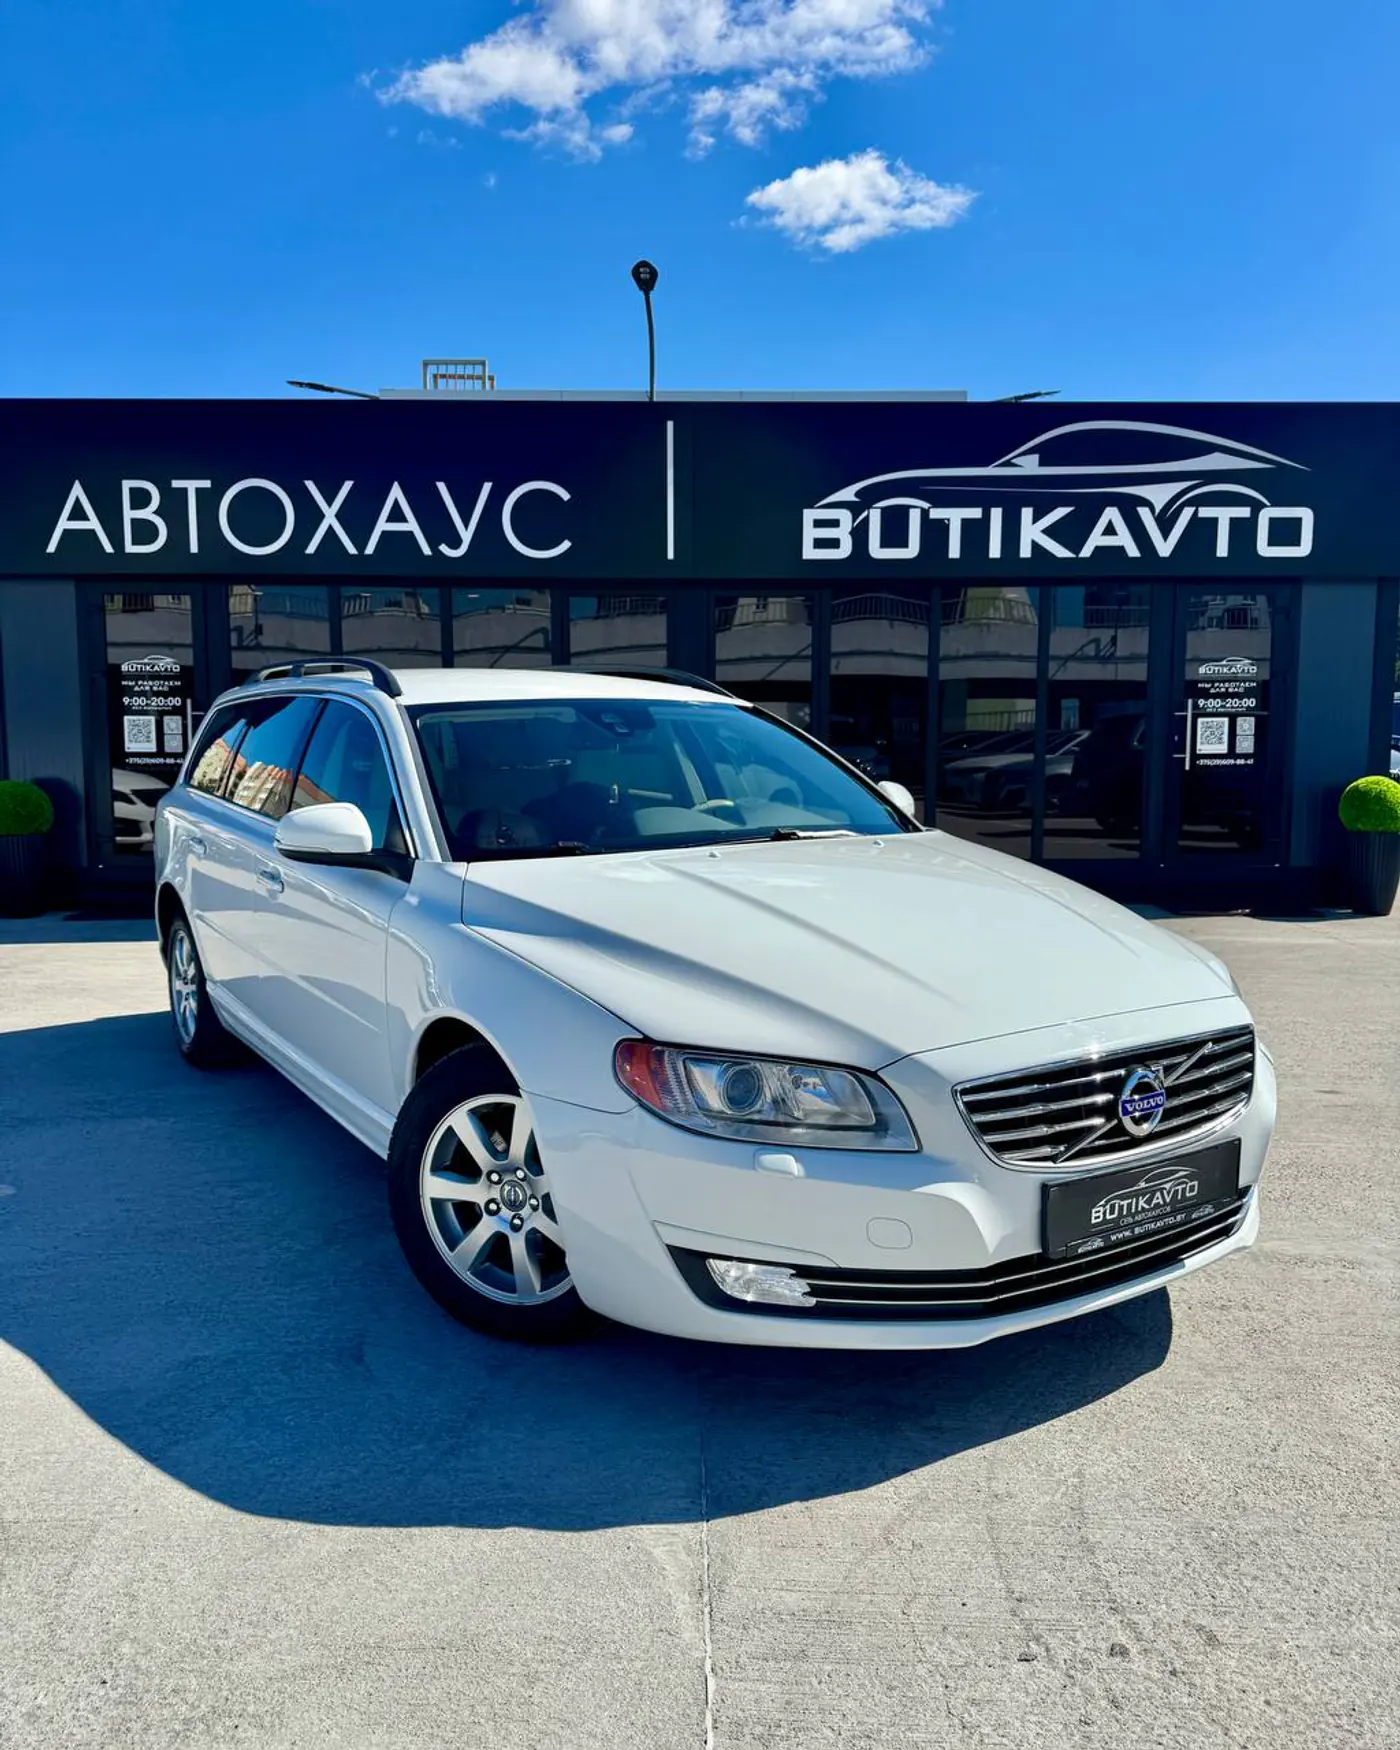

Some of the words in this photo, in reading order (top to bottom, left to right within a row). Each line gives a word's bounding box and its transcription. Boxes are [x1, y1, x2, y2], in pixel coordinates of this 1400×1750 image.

[46, 478, 572, 559] АВТОХАУС
[802, 506, 1314, 560] BUTIKAVTO
[121, 664, 181, 672] BUTIKAVTO
[1198, 665, 1258, 674] BUTIKAVTO
[122, 696, 182, 706] 9:00-20:00
[1197, 698, 1256, 708] 9:00-20:00
[1124, 1095, 1164, 1112] VOLVO
[1091, 1181, 1199, 1225] BUTIKAVTO
